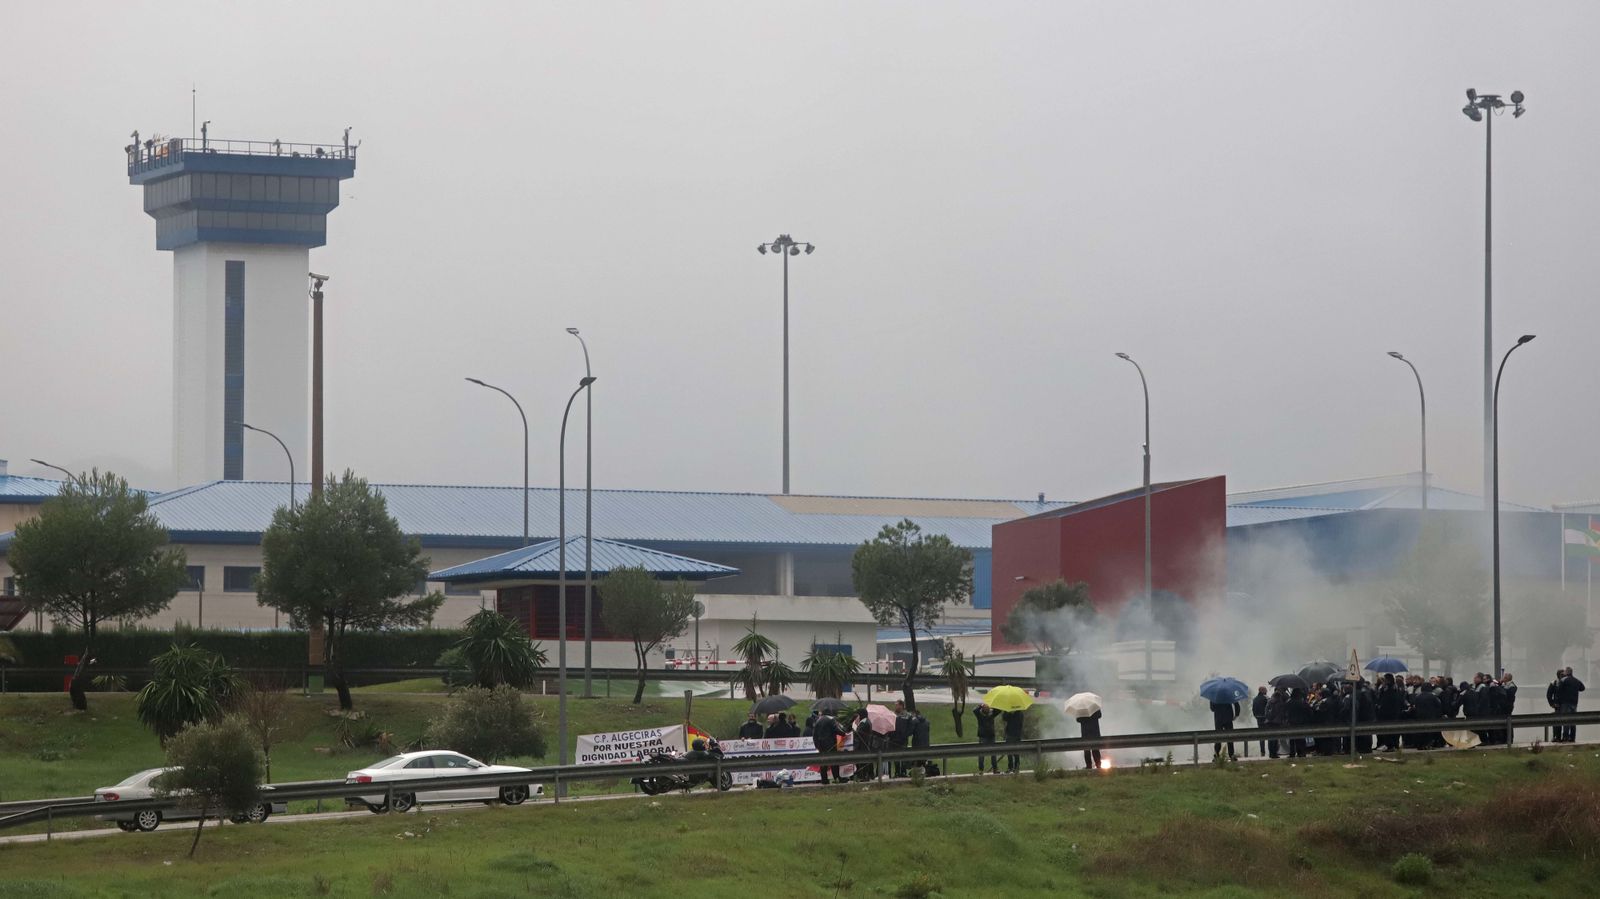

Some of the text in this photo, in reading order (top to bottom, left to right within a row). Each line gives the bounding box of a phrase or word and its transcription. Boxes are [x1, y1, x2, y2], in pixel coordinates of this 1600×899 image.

[594, 729, 662, 744] C.P. ALGECIRAS
[593, 738, 663, 752] POR NUESTRA
[581, 752, 627, 762] DIGNIDAD
[630, 745, 678, 758] LABORAL
